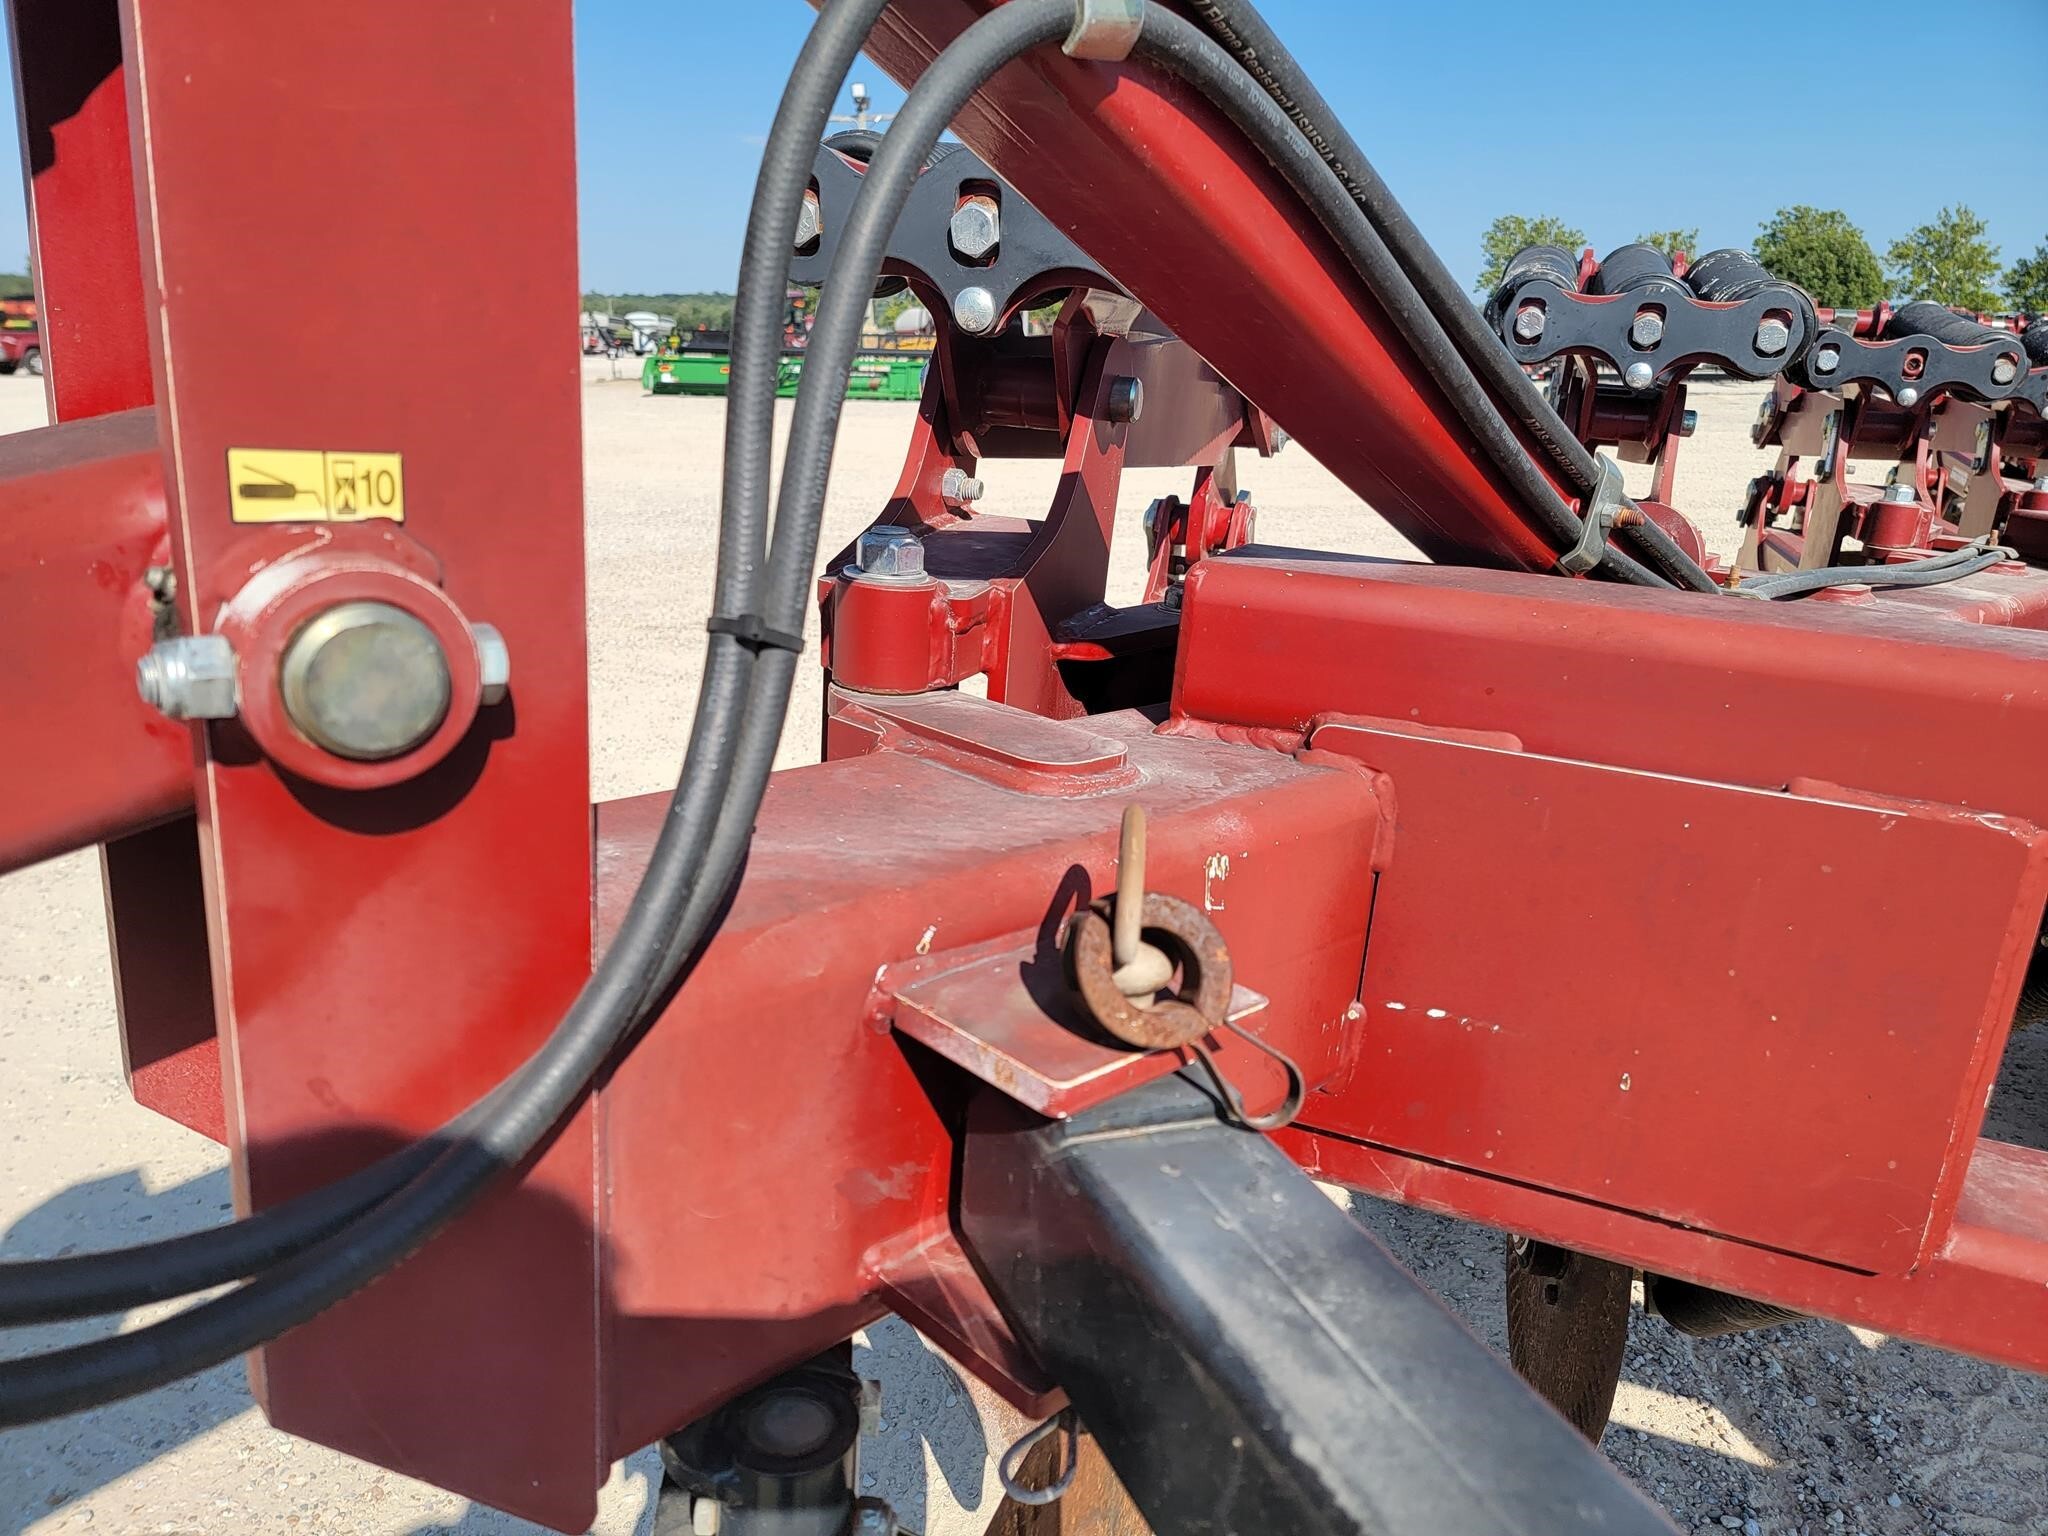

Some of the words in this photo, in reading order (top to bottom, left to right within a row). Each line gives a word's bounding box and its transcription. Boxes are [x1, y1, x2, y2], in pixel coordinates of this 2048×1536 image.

[1202, 5, 1243, 49] Flame
[1239, 46, 1295, 108] Resistant
[360, 469, 396, 507] 10
